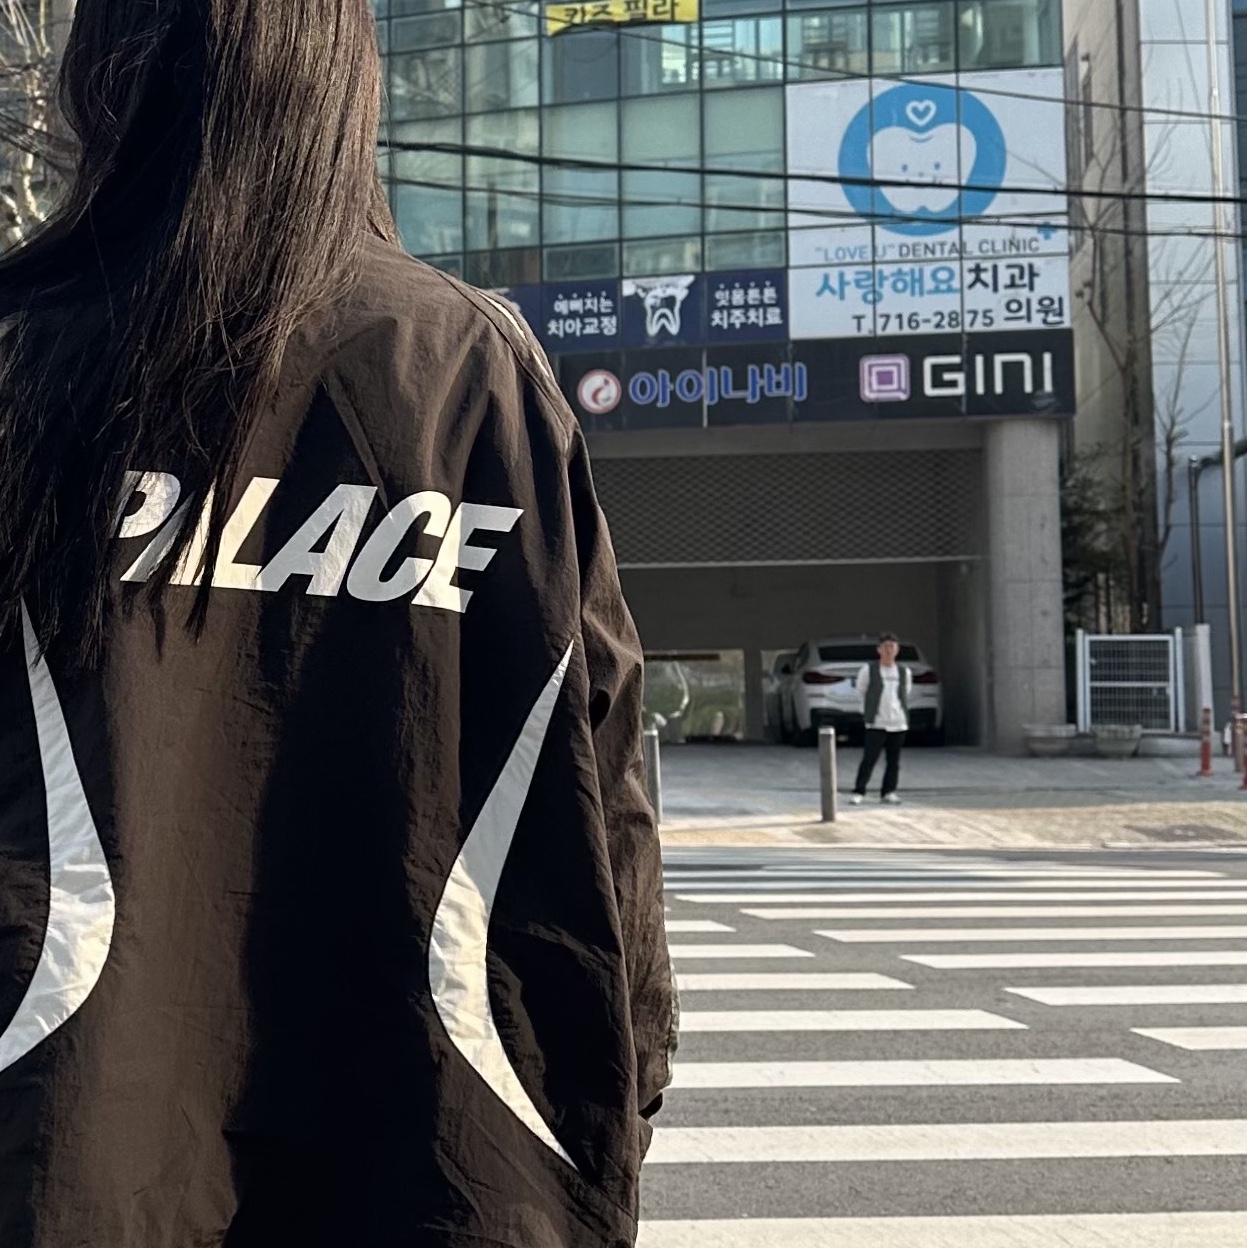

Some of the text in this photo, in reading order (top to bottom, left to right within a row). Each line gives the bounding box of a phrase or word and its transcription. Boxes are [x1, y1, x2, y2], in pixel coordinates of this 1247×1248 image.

[899, 239, 967, 258] DENTAL
[978, 236, 1041, 253] CLINIC
[714, 286, 778, 306] 잇몸튼튼
[816, 262, 1040, 305] 사랑해요 치과
[553, 296, 613, 314] 예뻐지는
[710, 308, 783, 329] 치주치료
[1003, 295, 1065, 327] 의원
[547, 316, 618, 338] 치아교정
[629, 362, 808, 408] 아이나비
[923, 351, 1052, 397] GINI
[110, 470, 525, 614] PALACE
